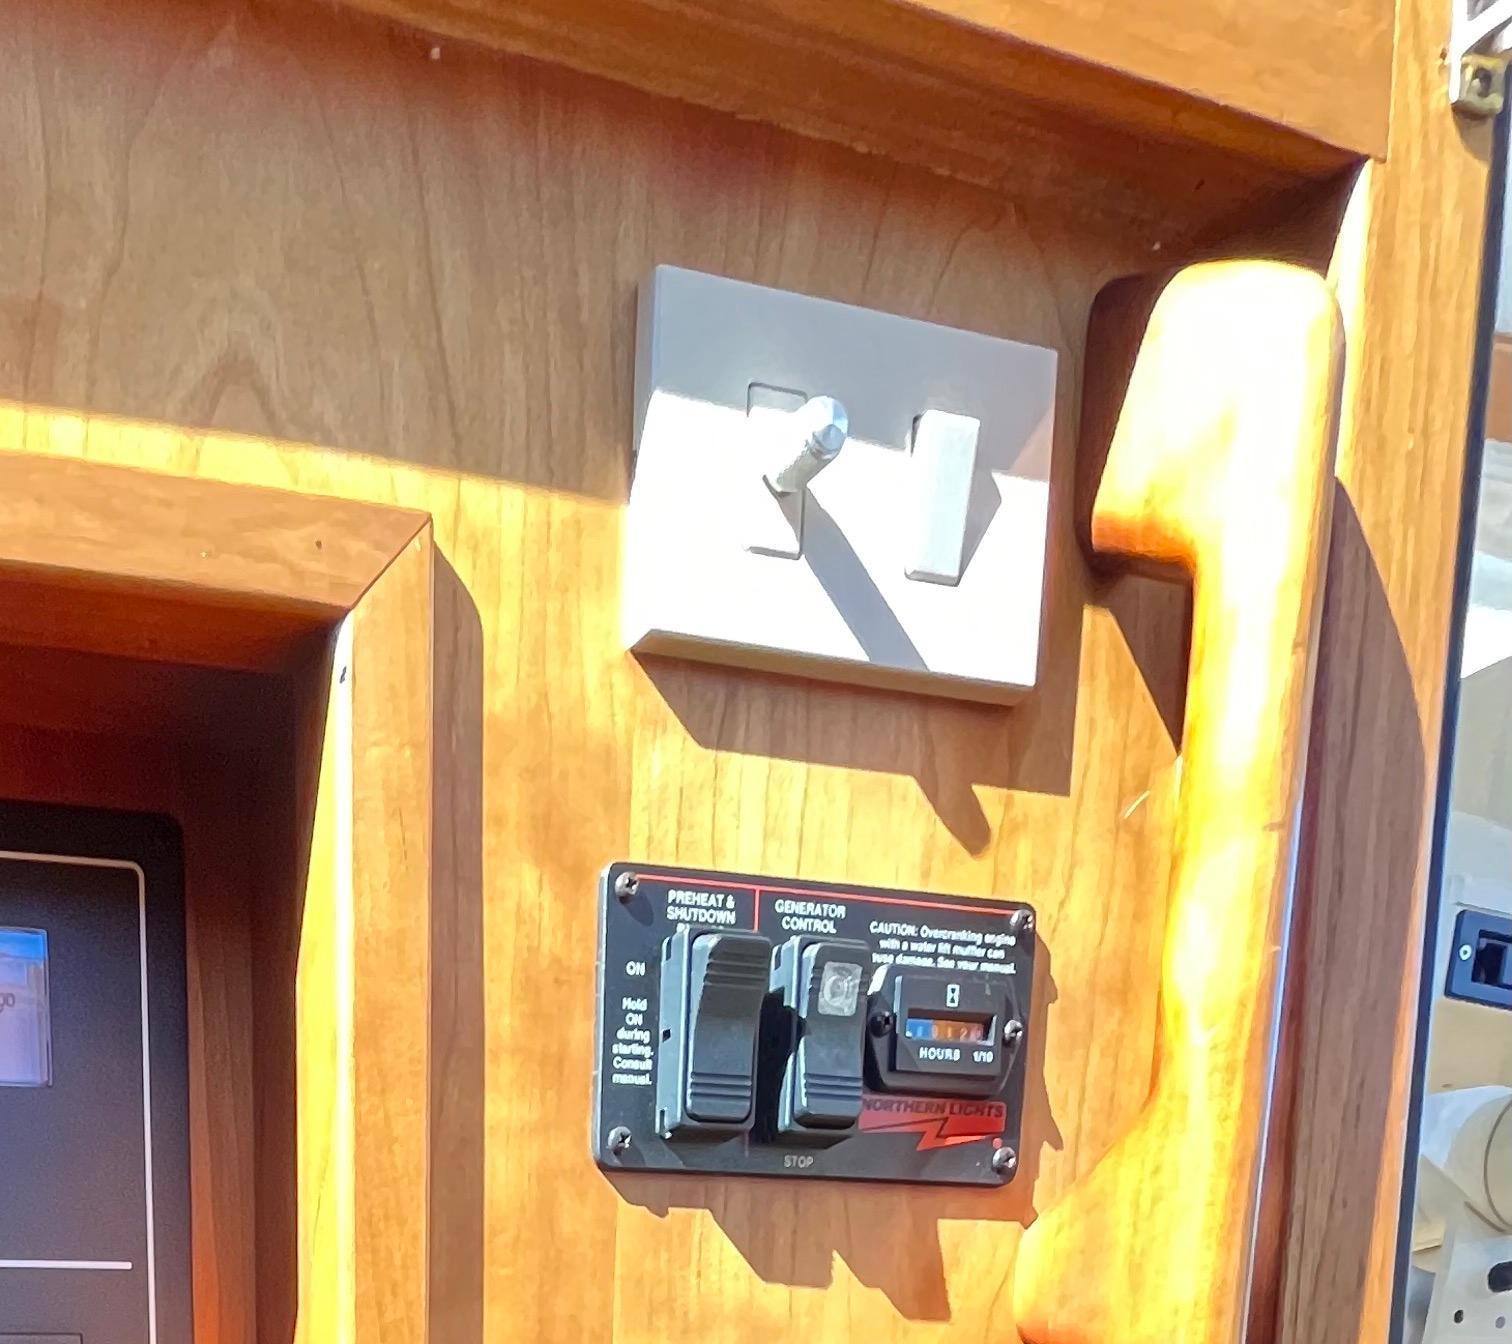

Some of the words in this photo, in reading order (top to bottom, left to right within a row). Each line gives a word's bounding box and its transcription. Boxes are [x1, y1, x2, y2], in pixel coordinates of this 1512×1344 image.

[667, 889, 724, 908] PREHEAT
[725, 895, 736, 908] &
[666, 906, 736, 924] SHUTDOWN
[775, 899, 846, 919] GENERATOR
[781, 916, 837, 935] CONTROL
[869, 921, 918, 937] CAUTION:
[879, 938, 900, 950] with
[626, 961, 646, 977] ON
[622, 997, 647, 1011] Hold
[625, 1012, 643, 1026] ON
[616, 1028, 650, 1044] during
[612, 1043, 654, 1058] starting.
[919, 1047, 961, 1062] HOURS
[613, 1057, 653, 1071] Consult
[862, 1098, 946, 1115] NORTHERN
[949, 1101, 1004, 1118] LIGHTS
[784, 1155, 814, 1168] STOP
